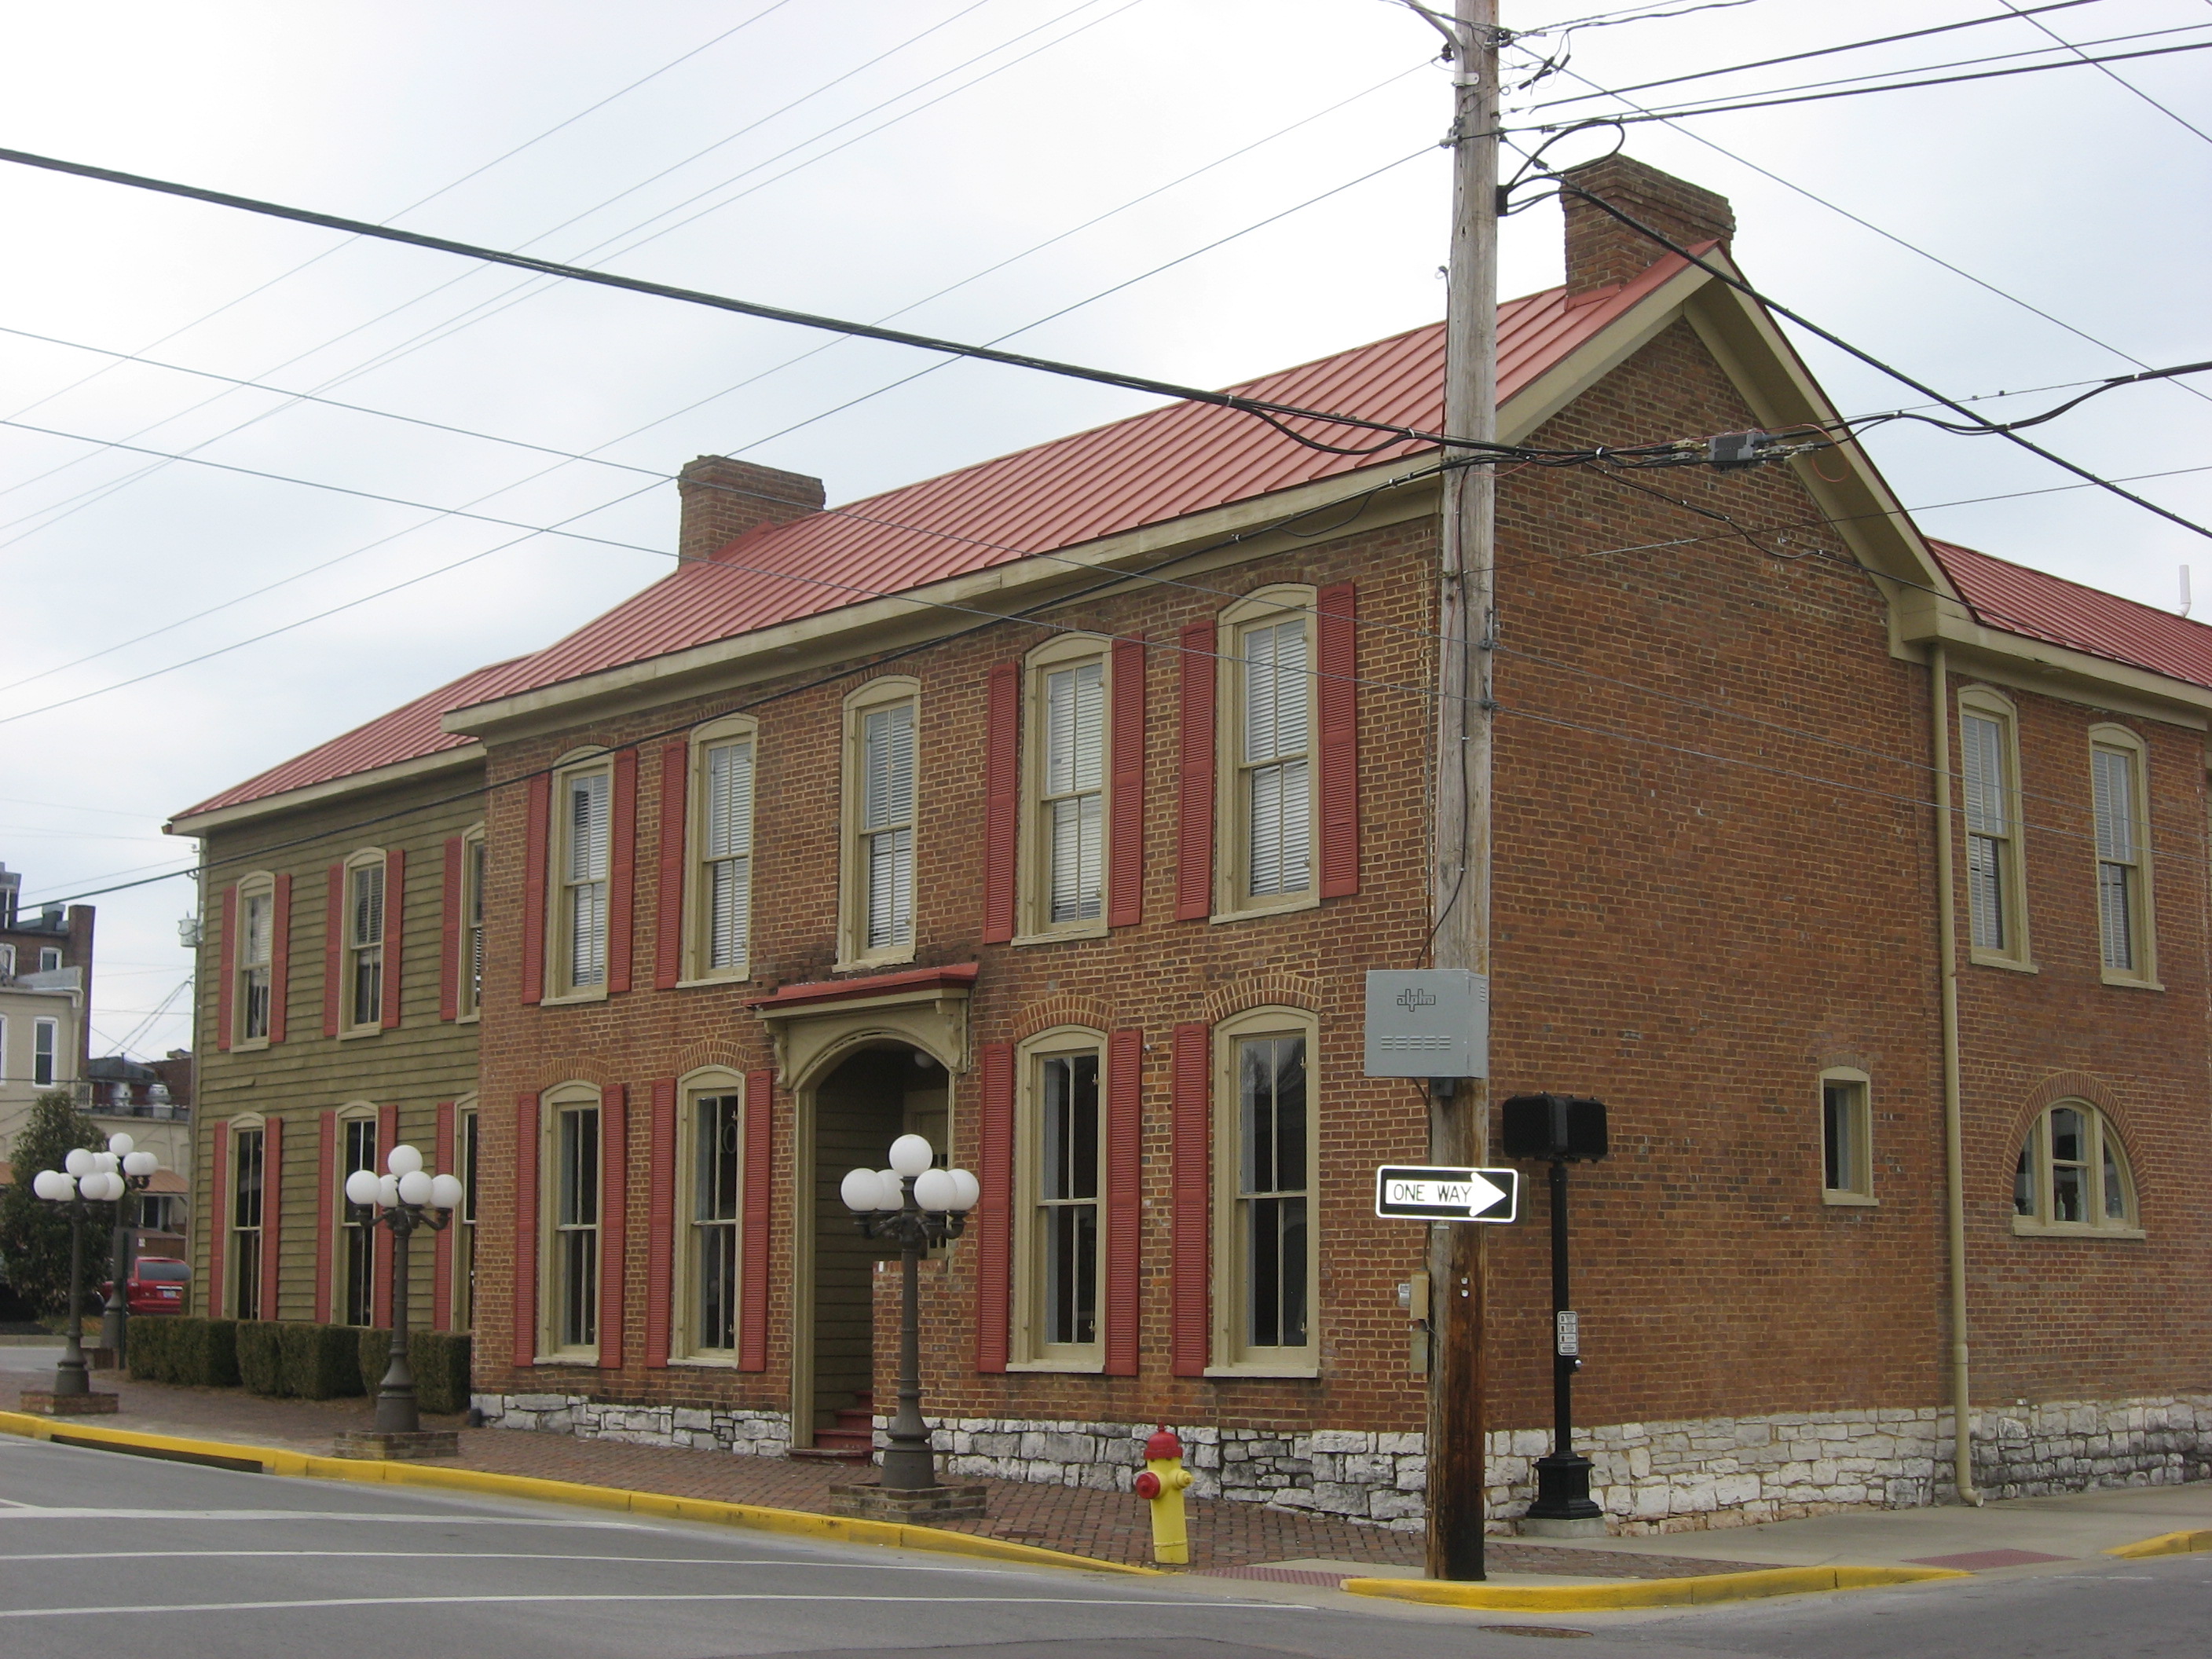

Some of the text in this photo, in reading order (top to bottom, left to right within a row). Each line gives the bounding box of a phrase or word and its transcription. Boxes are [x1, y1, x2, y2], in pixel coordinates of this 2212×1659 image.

[1397, 988, 1436, 1013] alpha
[1393, 1184, 1472, 1203] ONE WAY
